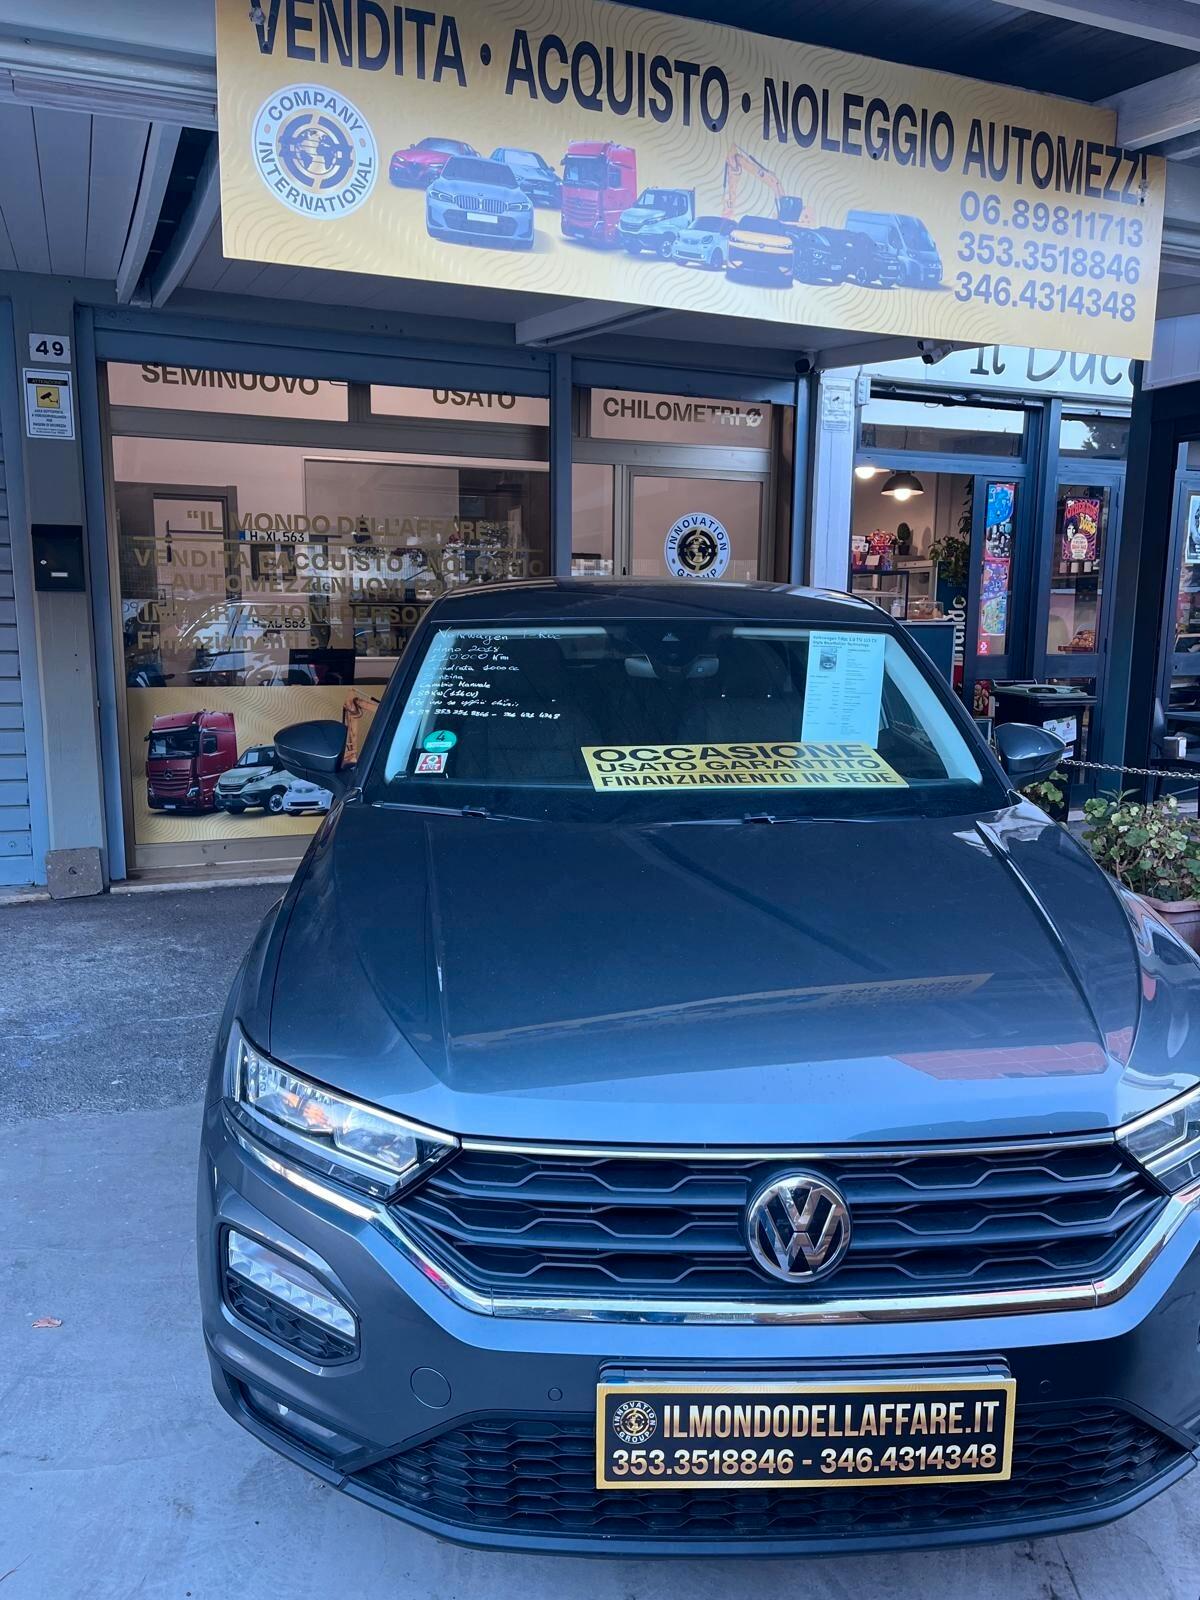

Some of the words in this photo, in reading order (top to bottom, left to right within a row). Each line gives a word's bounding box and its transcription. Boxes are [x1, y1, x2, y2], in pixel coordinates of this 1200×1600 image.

[249, 0, 468, 87] VENDITA
[505, 29, 729, 134] ACQUISTO
[763, 77, 955, 172] NOLEGGIO
[962, 118, 1147, 206] AUTOMEZZI
[268, 90, 363, 132] COMPANY
[259, 141, 372, 213] INTERNATIONAL
[959, 190, 1144, 247] 06.89811713
[957, 231, 1140, 285] 353.3518846
[954, 272, 1136, 322] 346.4314348
[36, 341, 64, 356] 49
[142, 365, 319, 395] SEMINUOVO
[1027, 347, 1136, 385] Duc
[432, 389, 516, 409] USATO
[230, 512, 330, 533] MONDO
[668, 517, 728, 551] INNOVATION
[134, 548, 249, 568] VENDITA
[677, 568, 718, 578] GUP
[592, 744, 873, 763] OCCASIONE
[596, 761, 697, 773] USATO
[705, 758, 881, 772] GARANTITO
[602, 772, 797, 787] FINANZIAMENTO
[804, 772, 830, 784] IN
[837, 772, 897, 783] SEDE
[614, 1402, 656, 1426] INNOVATION
[663, 1401, 1000, 1438] ILMONDODELLAFFARE.IT
[619, 1431, 650, 1443] GROUP
[612, 1448, 795, 1477] 353.3518846
[820, 1443, 997, 1474] 346.4314348
